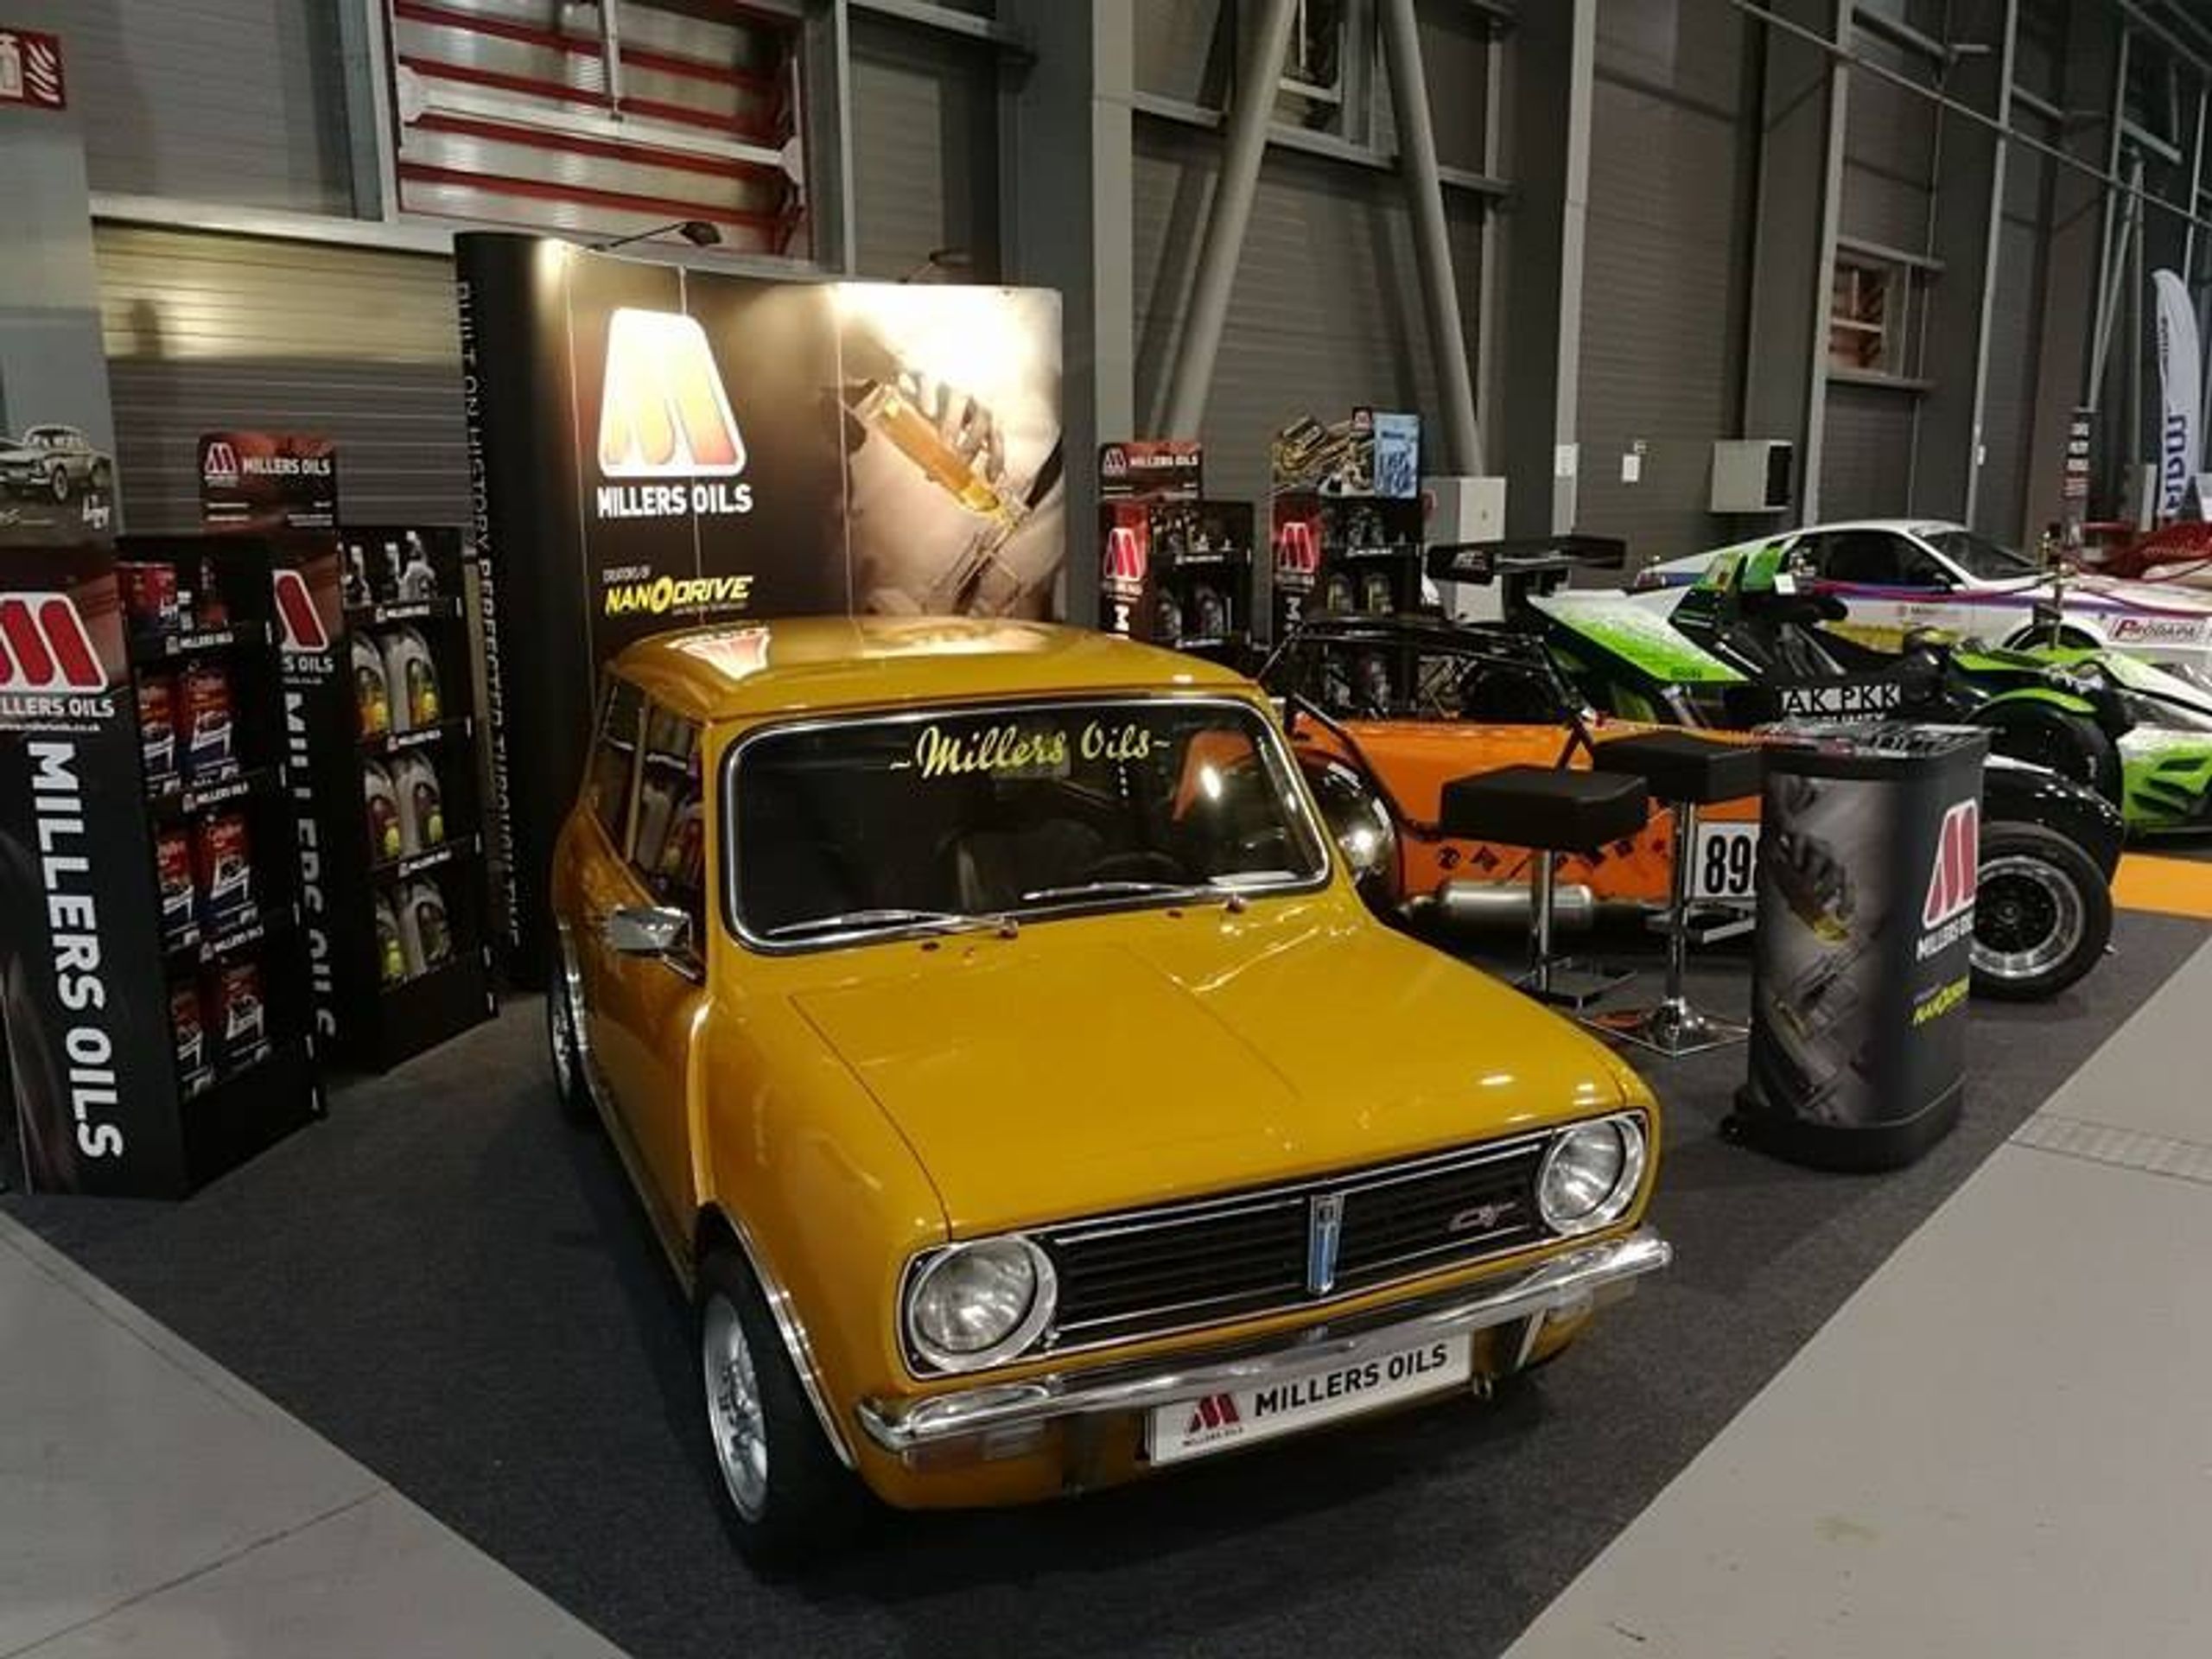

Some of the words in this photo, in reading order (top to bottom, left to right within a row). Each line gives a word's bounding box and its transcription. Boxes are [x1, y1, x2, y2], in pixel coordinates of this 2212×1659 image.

[242, 457, 300, 474] MILLERS
[302, 458, 332, 474] OILS
[597, 485, 687, 518] MILLERS
[692, 484, 753, 513] OILS
[606, 575, 753, 615] NANODRIVE
[298, 657, 334, 673] OILS
[0, 696, 66, 717] LLERS
[68, 697, 115, 718] OILS
[916, 725, 1067, 779] Millers
[1080, 720, 1152, 760] Oils
[28, 740, 105, 1011] MILLERS
[1705, 835, 1760, 895] 89
[66, 1027, 124, 1159] OILS
[1254, 1362, 1379, 1417] MILLERS
[1387, 1344, 1448, 1382] OILS
